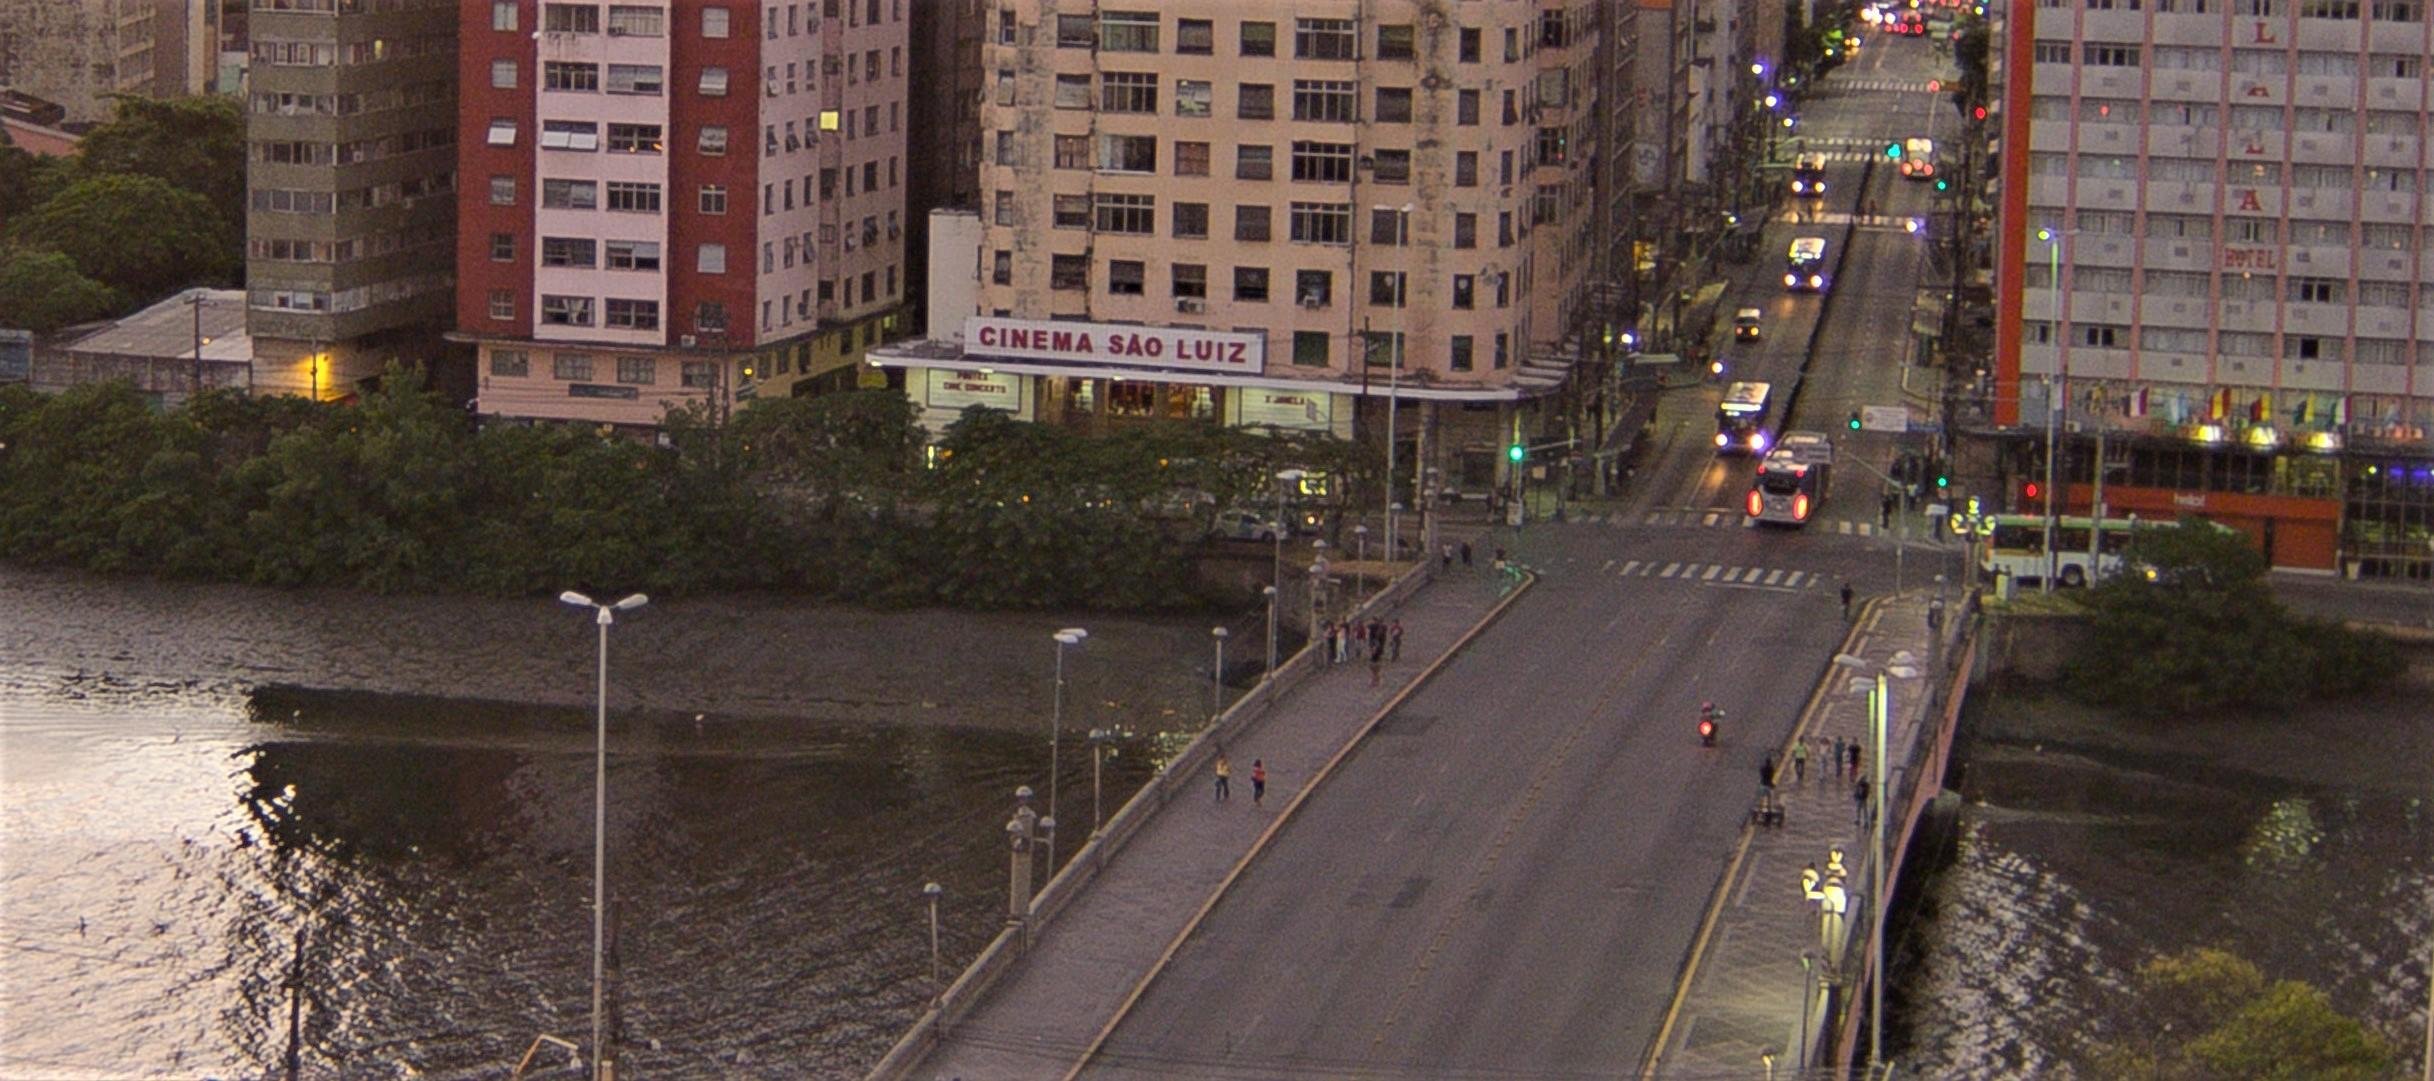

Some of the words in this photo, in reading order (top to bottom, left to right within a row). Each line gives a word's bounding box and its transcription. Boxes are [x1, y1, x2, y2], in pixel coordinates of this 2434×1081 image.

[2225, 248, 2277, 269] HOTEL
[979, 326, 1094, 353] CINEMA
[1108, 333, 1163, 357] SÃO
[1177, 339, 1247, 363] LUIZ
